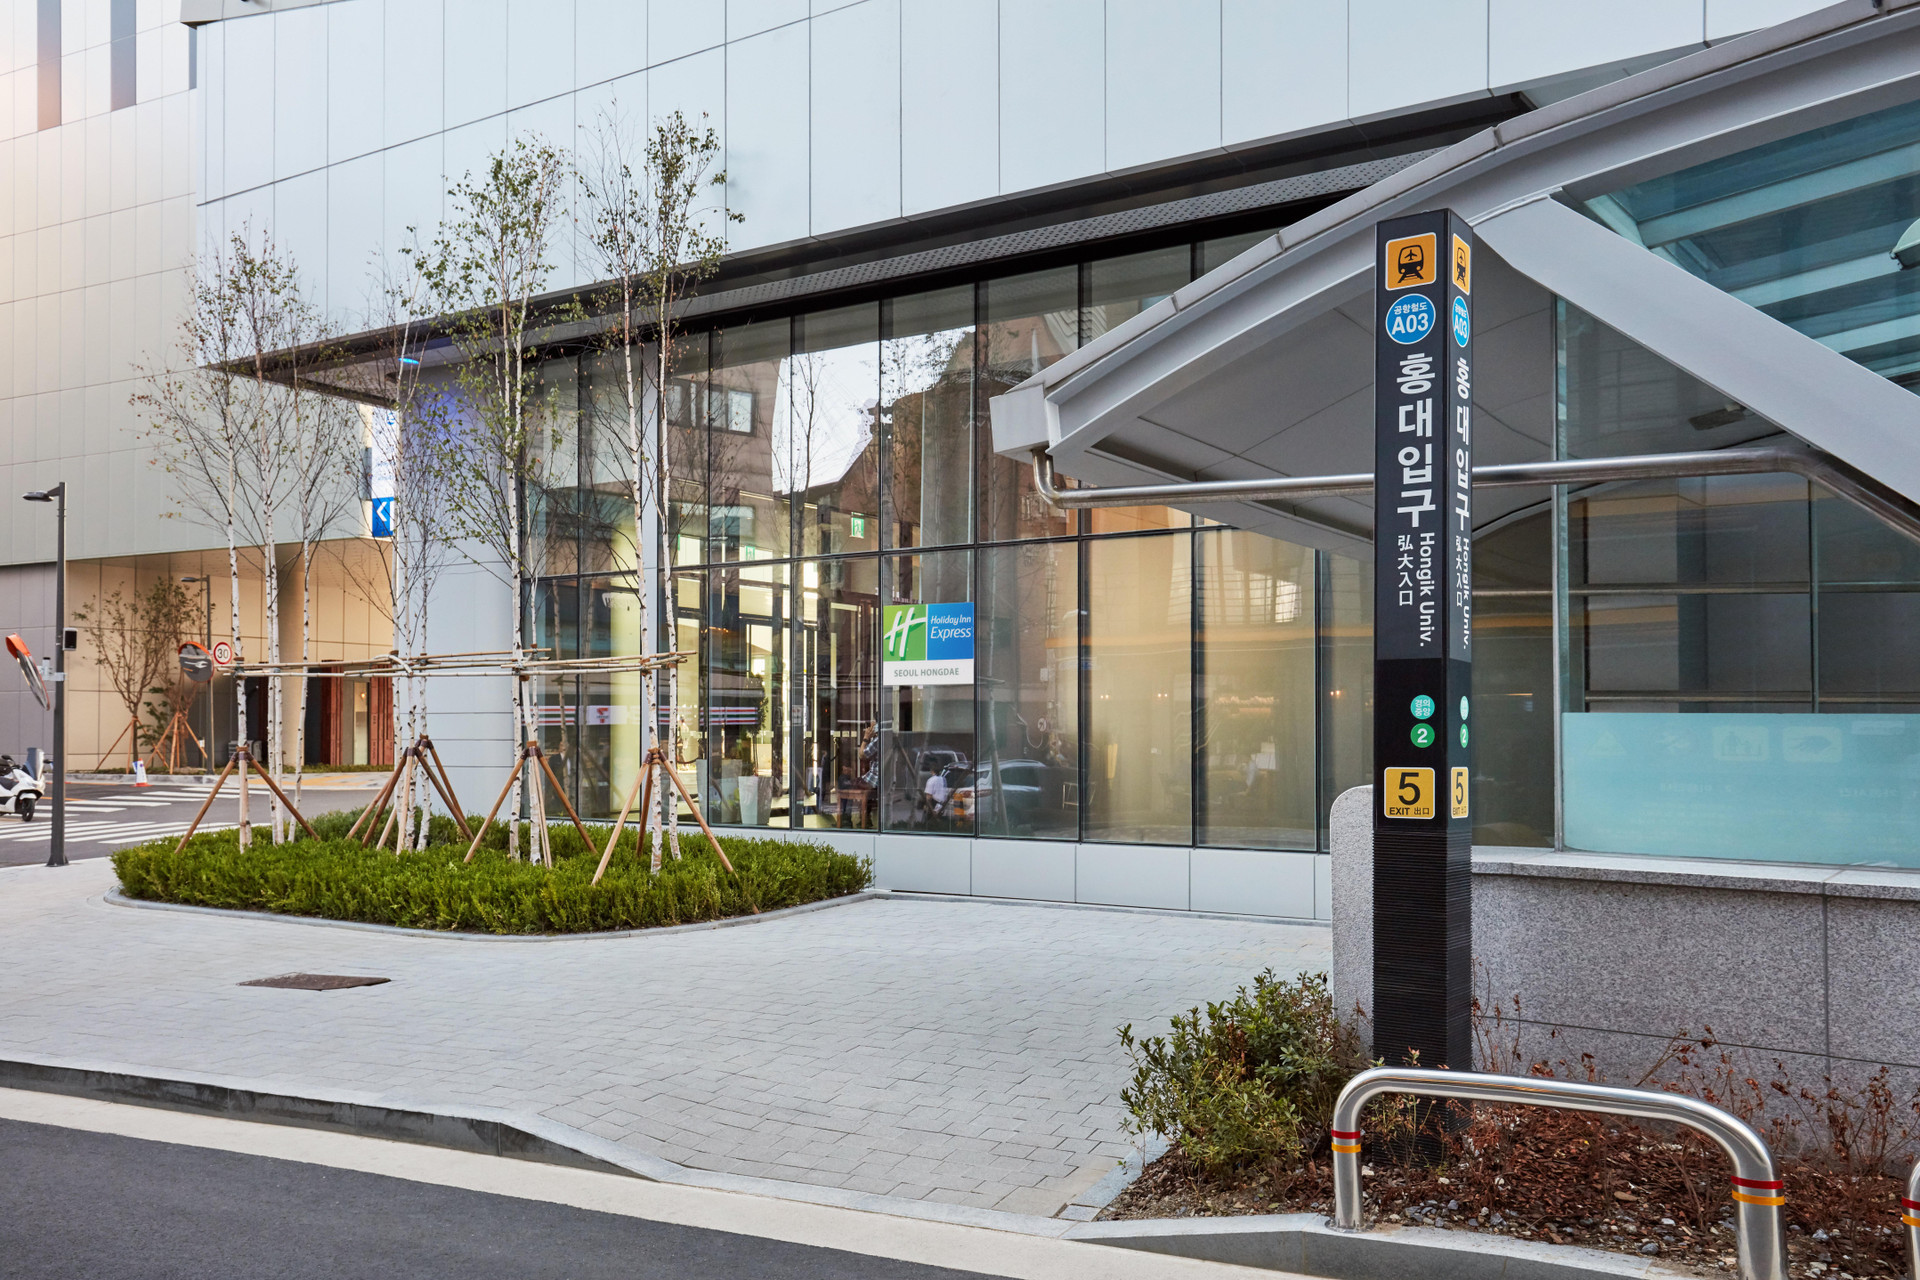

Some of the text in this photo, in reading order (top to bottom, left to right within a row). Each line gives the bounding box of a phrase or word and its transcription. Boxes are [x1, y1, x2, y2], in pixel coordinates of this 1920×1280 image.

[1393, 302, 1428, 315] 공항철도
[1391, 312, 1429, 335] A03
[1453, 314, 1467, 339] A03
[1396, 353, 1436, 528] 홍대입구
[1455, 357, 1471, 532] 홍대입구
[1397, 534, 1414, 607] 弘大入口
[1462, 537, 1470, 601] Hongik
[1416, 532, 1435, 647] Hongik Univ.
[930, 614, 972, 626] Holiday Inn
[930, 626, 972, 642] Express
[217, 648, 229, 659] 30
[894, 667, 960, 677] SEOUL HONGDAE
[1417, 728, 1428, 743] 2
[1462, 728, 1467, 743] 2
[1398, 772, 1421, 806] 5
[1455, 772, 1464, 805] 5
[1389, 807, 1411, 815] EXIT
[1413, 807, 1430, 815] 出口
